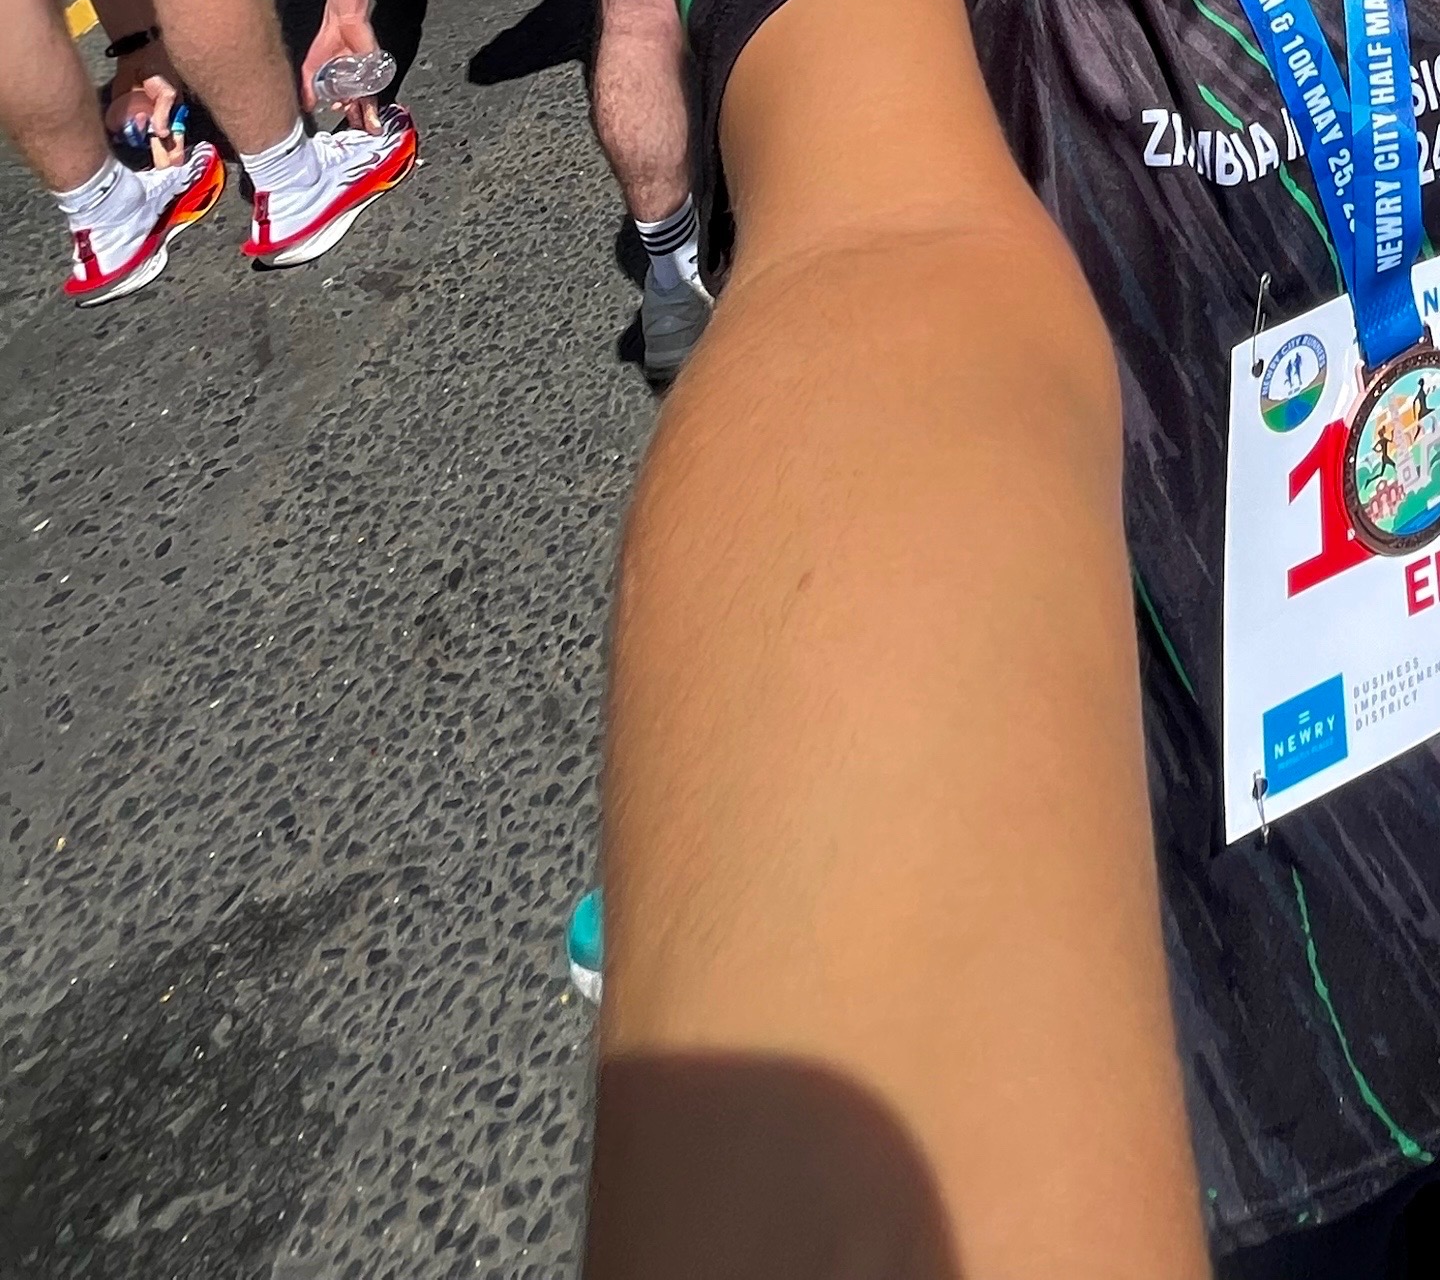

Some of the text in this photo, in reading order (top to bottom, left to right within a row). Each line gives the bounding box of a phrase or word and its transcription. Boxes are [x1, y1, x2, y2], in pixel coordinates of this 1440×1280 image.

[1280, 33, 1319, 89] 10K
[1302, 83, 1345, 147] MAY
[1367, 42, 1398, 106] HALF
[1371, 109, 1401, 172] CITY
[1375, 183, 1403, 274] NEWRY
[1352, 656, 1420, 700] BUSINESS
[1273, 714, 1337, 761] NEWRY
[1355, 689, 1419, 732] DISTRICT
